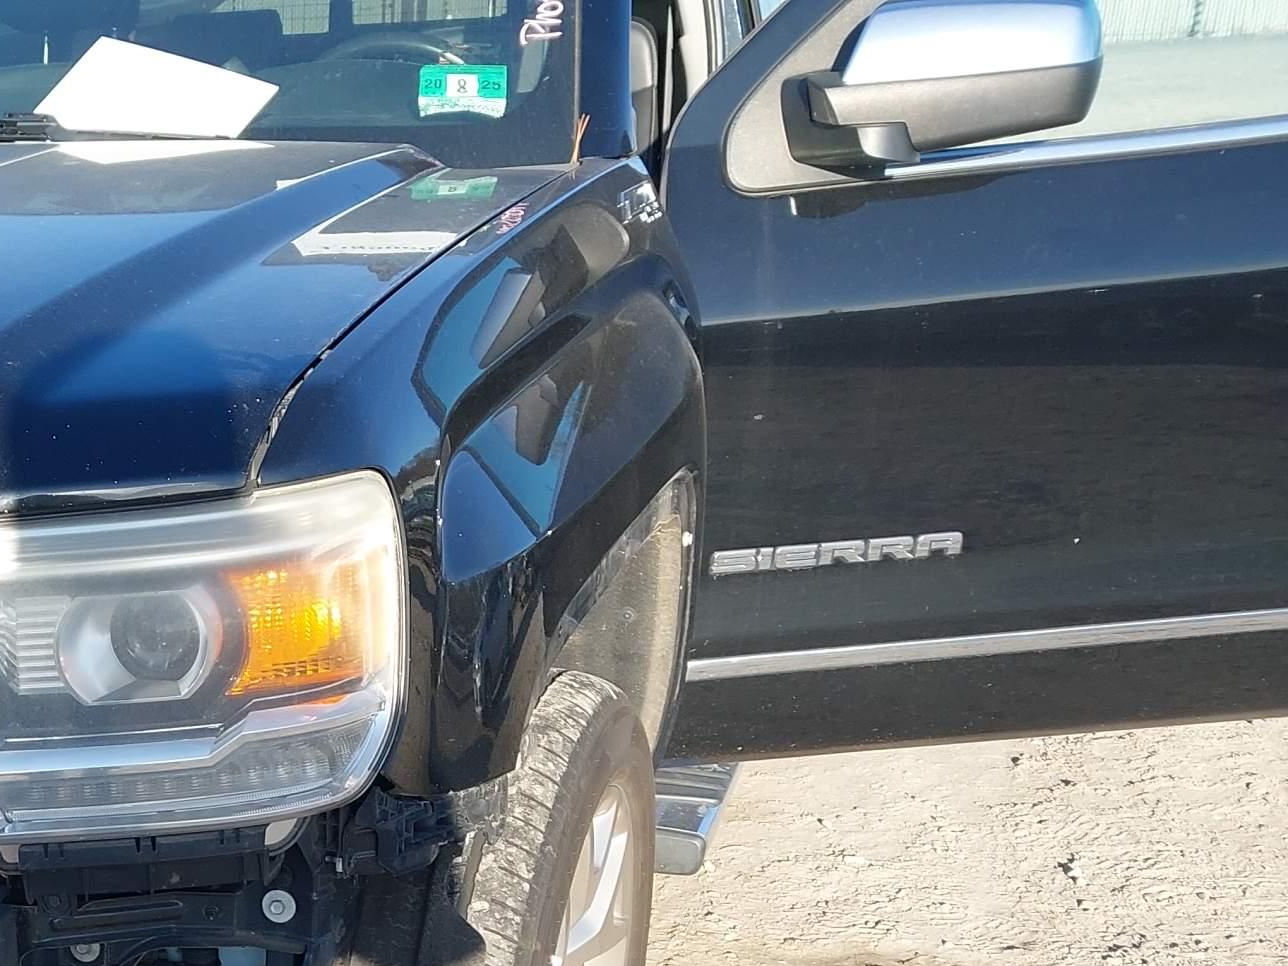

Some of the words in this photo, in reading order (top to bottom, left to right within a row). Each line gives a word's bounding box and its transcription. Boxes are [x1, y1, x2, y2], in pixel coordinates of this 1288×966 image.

[520, 0, 564, 45] Pho
[424, 78, 442, 89] 20
[481, 80, 502, 91] 25
[710, 531, 963, 575] SIERRA
